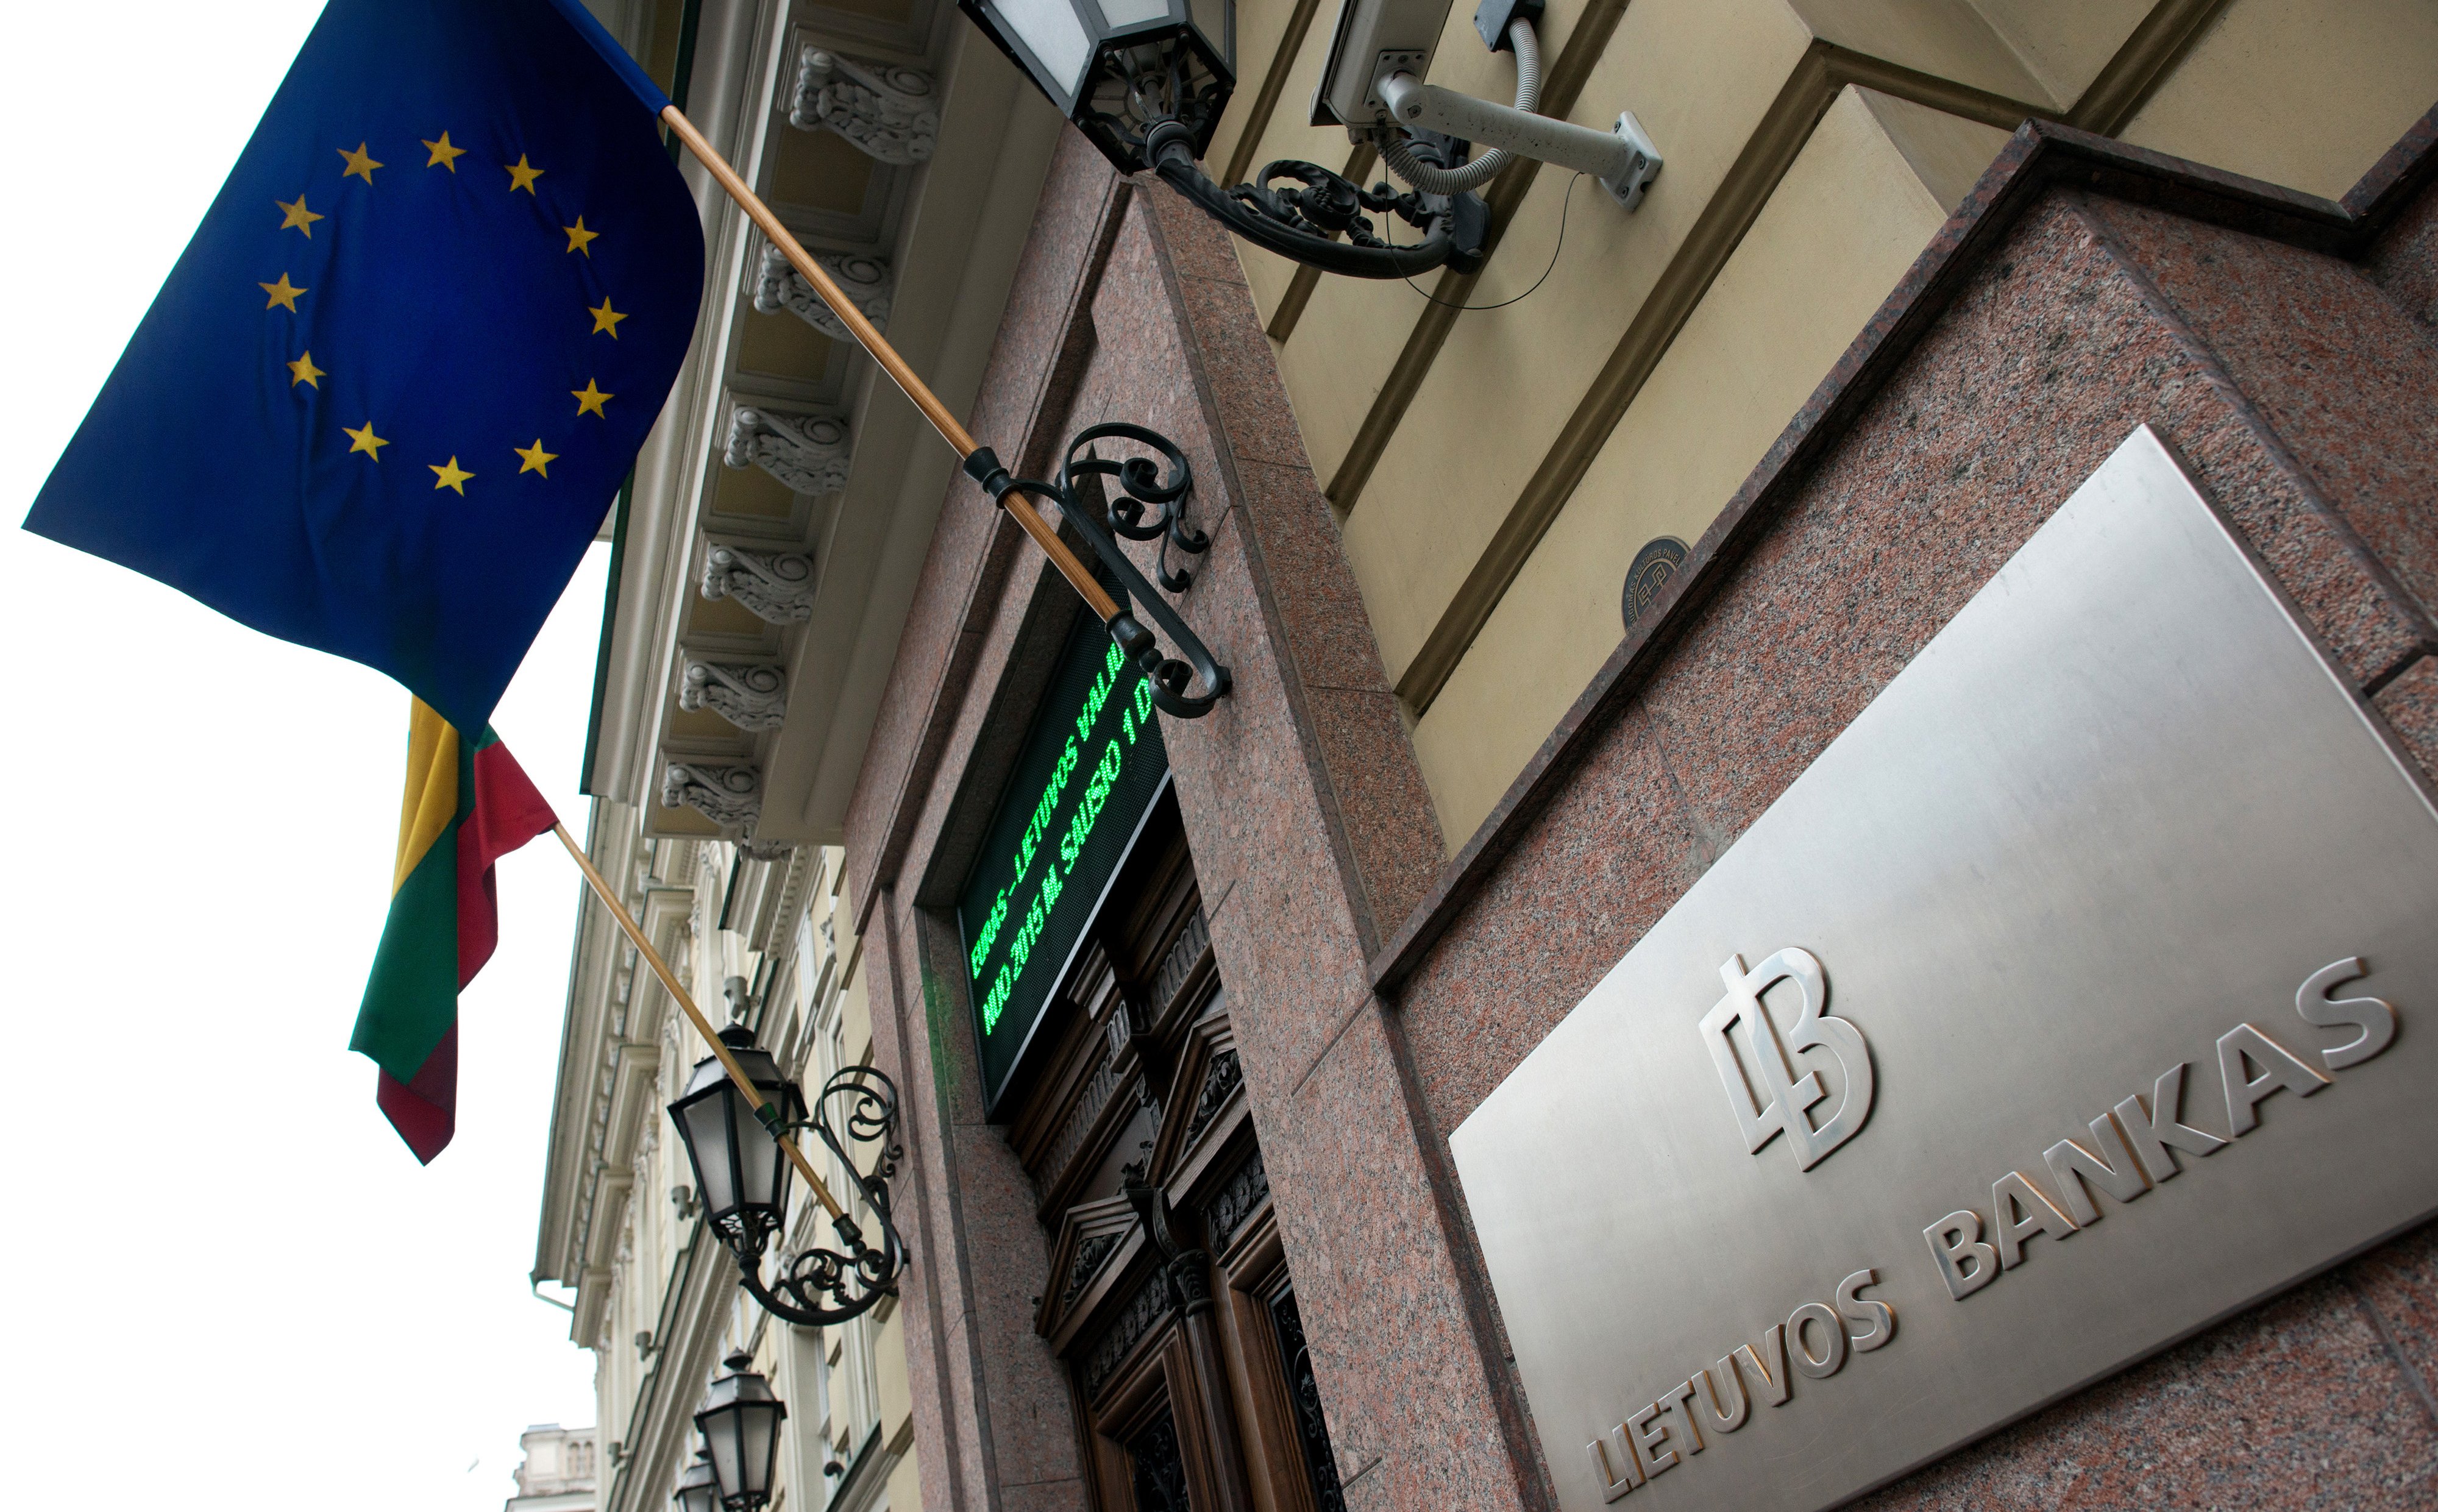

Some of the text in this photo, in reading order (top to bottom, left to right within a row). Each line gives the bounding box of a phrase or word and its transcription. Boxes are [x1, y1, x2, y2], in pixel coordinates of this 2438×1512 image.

[1627, 581, 1637, 631] UGOMAS
[1663, 548, 1681, 566] PAVEL
[971, 889, 1007, 979] EURAS
[1015, 734, 1078, 884] LIETUVOS
[1076, 642, 1125, 742] VALIU
[983, 962, 1012, 1035] NUO
[1010, 892, 1044, 981] 2015
[1041, 862, 1063, 915] M.
[1061, 739, 1121, 875] SAUSIO
[1123, 707, 1136, 745] 1
[1585, 955, 2399, 1505] LIETUVOS BANKAS
